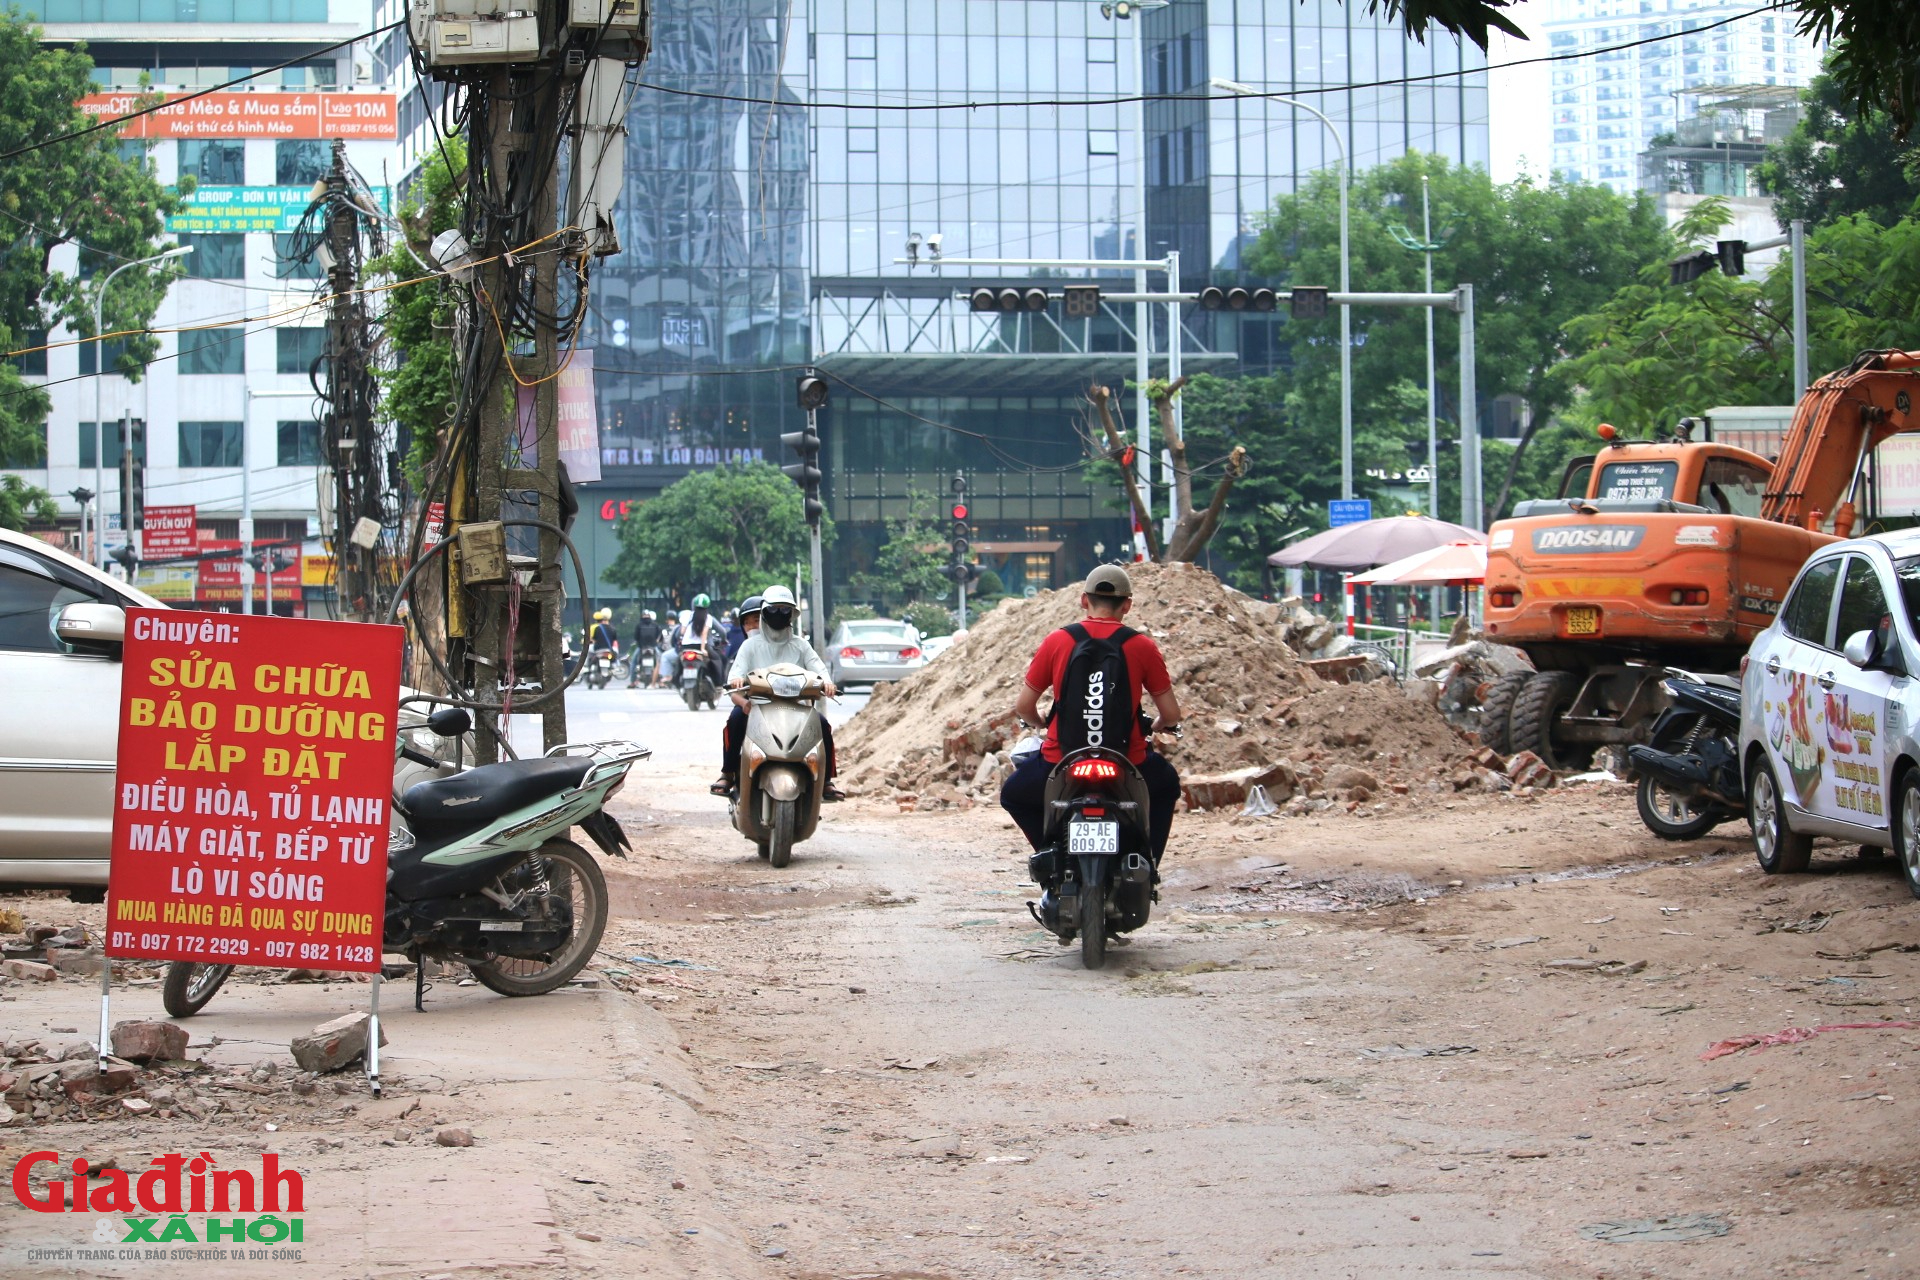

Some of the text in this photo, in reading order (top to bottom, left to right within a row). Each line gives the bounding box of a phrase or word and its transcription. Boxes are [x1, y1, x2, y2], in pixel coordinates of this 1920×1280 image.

[190, 99, 223, 115] Mèo
[228, 100, 239, 115] &
[244, 100, 279, 115] Mua
[284, 97, 316, 115] sắm
[332, 102, 386, 117] vào 10M
[171, 121, 193, 135] Mọi
[197, 121, 219, 133] thứ
[220, 121, 234, 133] có
[237, 120, 264, 133] hình
[340, 124, 360, 133] 0387
[362, 124, 377, 133] 415
[377, 124, 394, 133] 056
[198, 191, 233, 203] GROUP
[242, 190, 265, 203] ĐƠN
[1538, 530, 1635, 550] DOOSAN
[1752, 584, 1774, 597] PLUS
[1744, 597, 1764, 610] DX
[133, 617, 239, 645] Chuyên:
[1571, 621, 1593, 633] 5532
[149, 650, 372, 699] SỬA CHỮA
[129, 690, 386, 742] BẢO DƯỠNG
[1083, 671, 1104, 747] adidas
[164, 733, 347, 785] LẮP ĐẶT
[122, 776, 383, 829] ĐIỀU HÒA, TỦ LẠNH
[1076, 823, 1111, 836] 29-AE
[129, 820, 375, 865] MÁY GIẶT, BẾP TỪ
[1071, 838, 1115, 851] 809.26
[171, 861, 324, 902] LÒ VI SÓNG
[116, 899, 157, 922] MUA
[163, 899, 213, 926] HÀNG
[220, 903, 244, 928] ĐÃ
[250, 907, 285, 930] QUA
[322, 912, 373, 938] DỤNG
[112, 932, 136, 949] ĐT:
[141, 934, 169, 951] 097
[176, 935, 204, 953] 172
[210, 937, 249, 956] 2929
[266, 941, 295, 959] 097
[300, 942, 329, 960] 982
[335, 944, 373, 963] 1428
